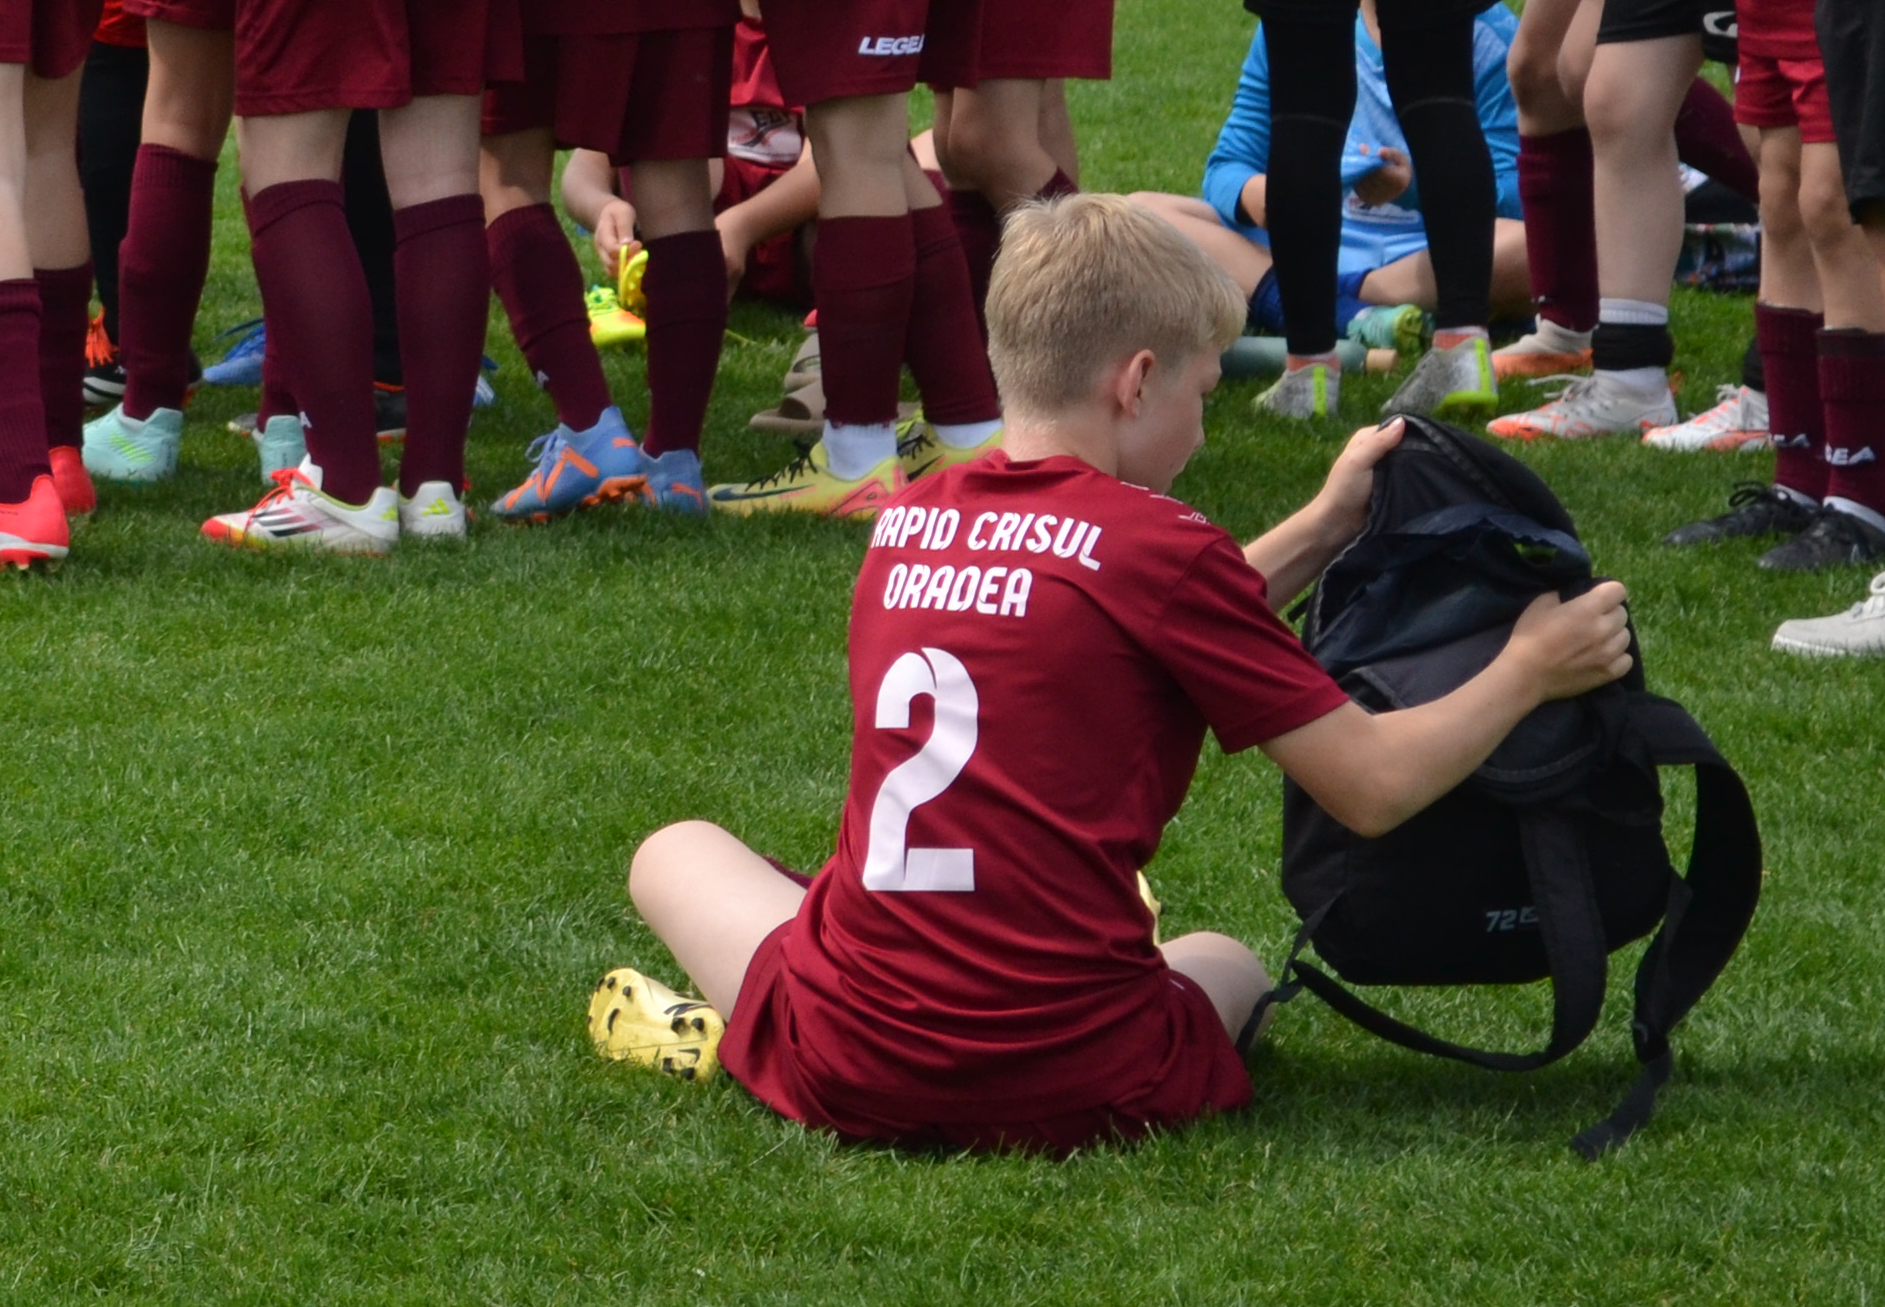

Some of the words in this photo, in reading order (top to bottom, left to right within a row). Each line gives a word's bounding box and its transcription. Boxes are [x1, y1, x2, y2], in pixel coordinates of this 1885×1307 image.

[871, 505, 961, 551] RAPID
[967, 508, 1102, 571] CRISUL
[882, 563, 1033, 617] ORADEA
[862, 646, 979, 892] 2
